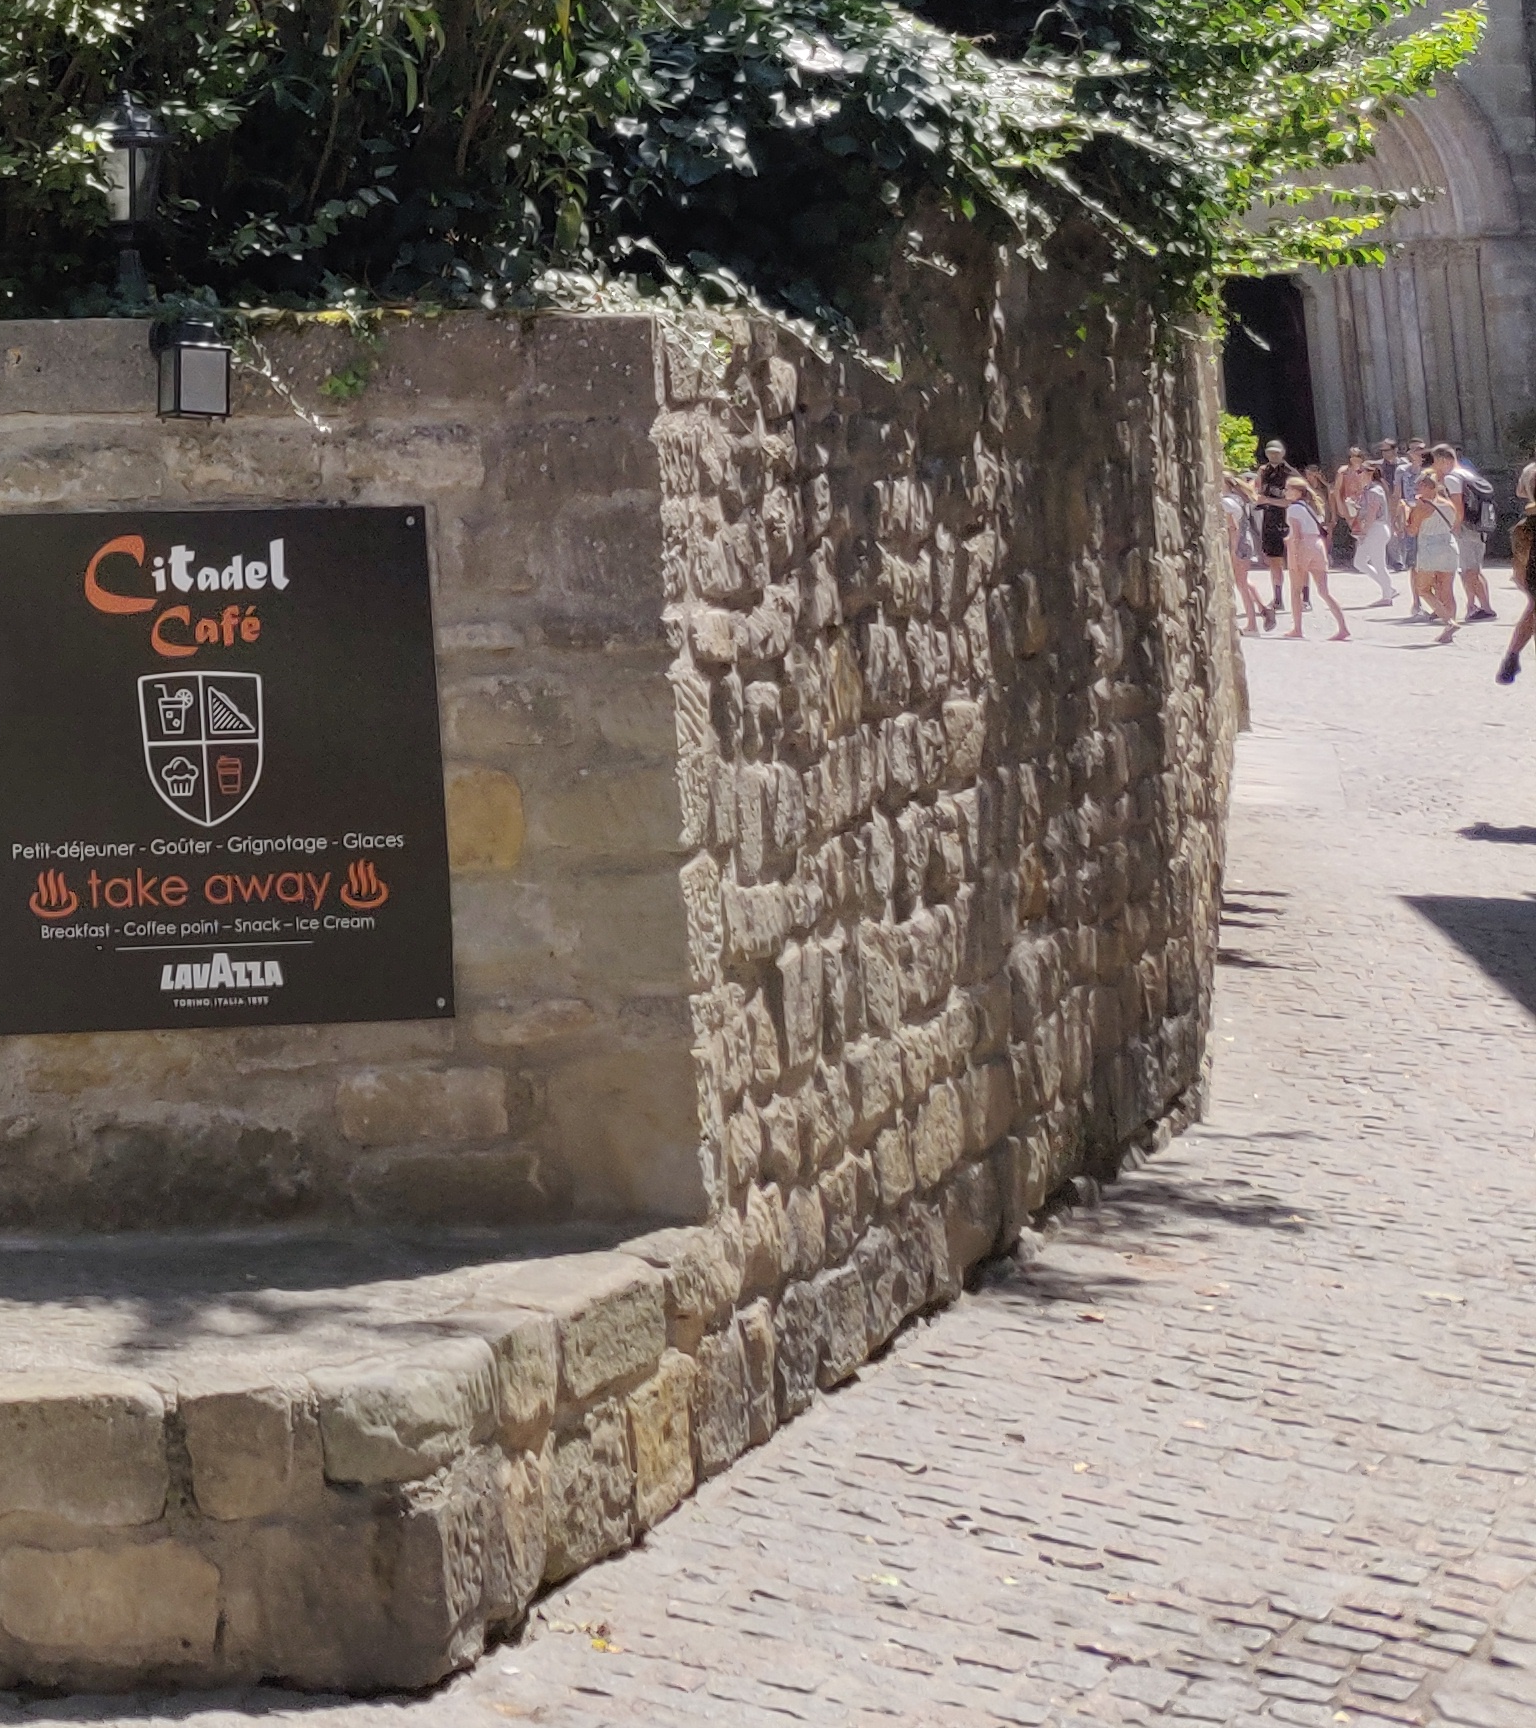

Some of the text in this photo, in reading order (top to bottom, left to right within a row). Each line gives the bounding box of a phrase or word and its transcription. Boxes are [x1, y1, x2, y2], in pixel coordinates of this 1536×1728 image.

[84, 534, 290, 614] Citadel
[150, 605, 262, 658] Café
[12, 832, 404, 862] Petit-déjeuner Goûter Grignotage Glaces
[87, 867, 331, 912] take away
[41, 915, 375, 939] Breakfast Coffee point Snack Ice Cream
[160, 952, 284, 990] LAVAZZA
